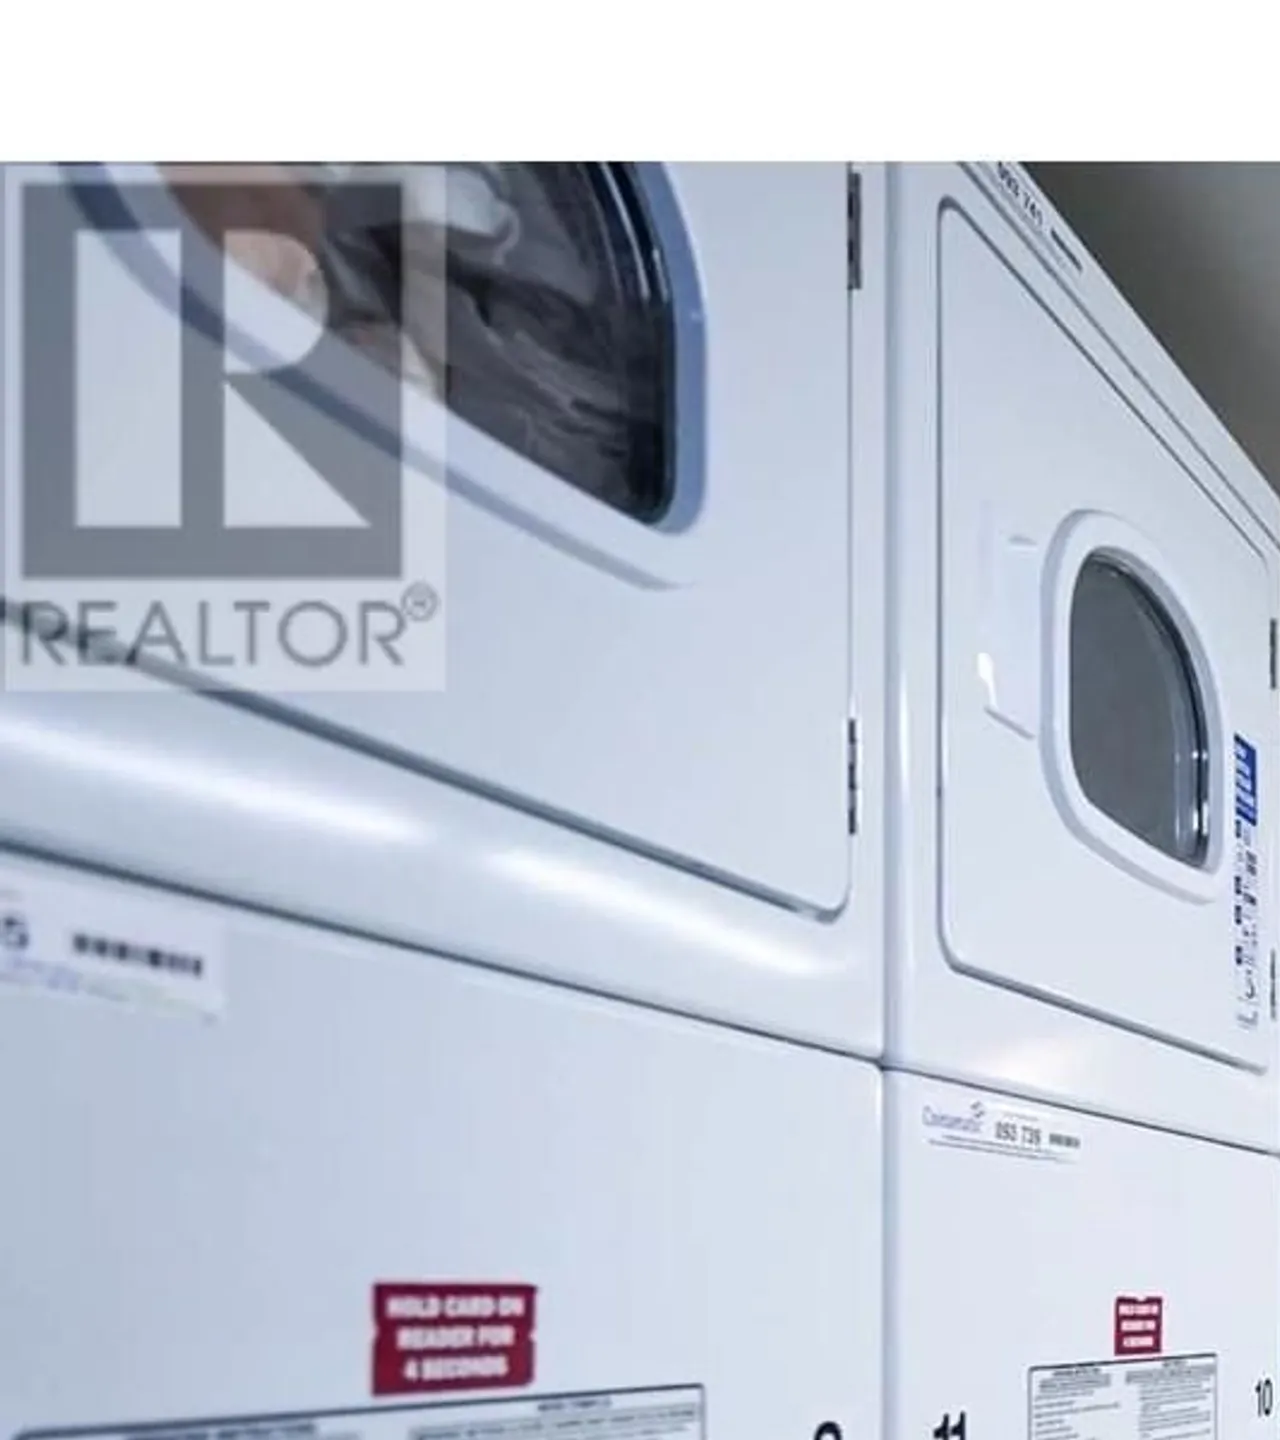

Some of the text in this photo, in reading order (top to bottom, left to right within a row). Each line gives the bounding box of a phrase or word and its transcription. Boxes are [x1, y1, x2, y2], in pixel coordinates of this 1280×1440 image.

[387, 1295, 440, 1319] HOLD
[444, 1295, 496, 1318] CARD
[1254, 1377, 1274, 1418] 10
